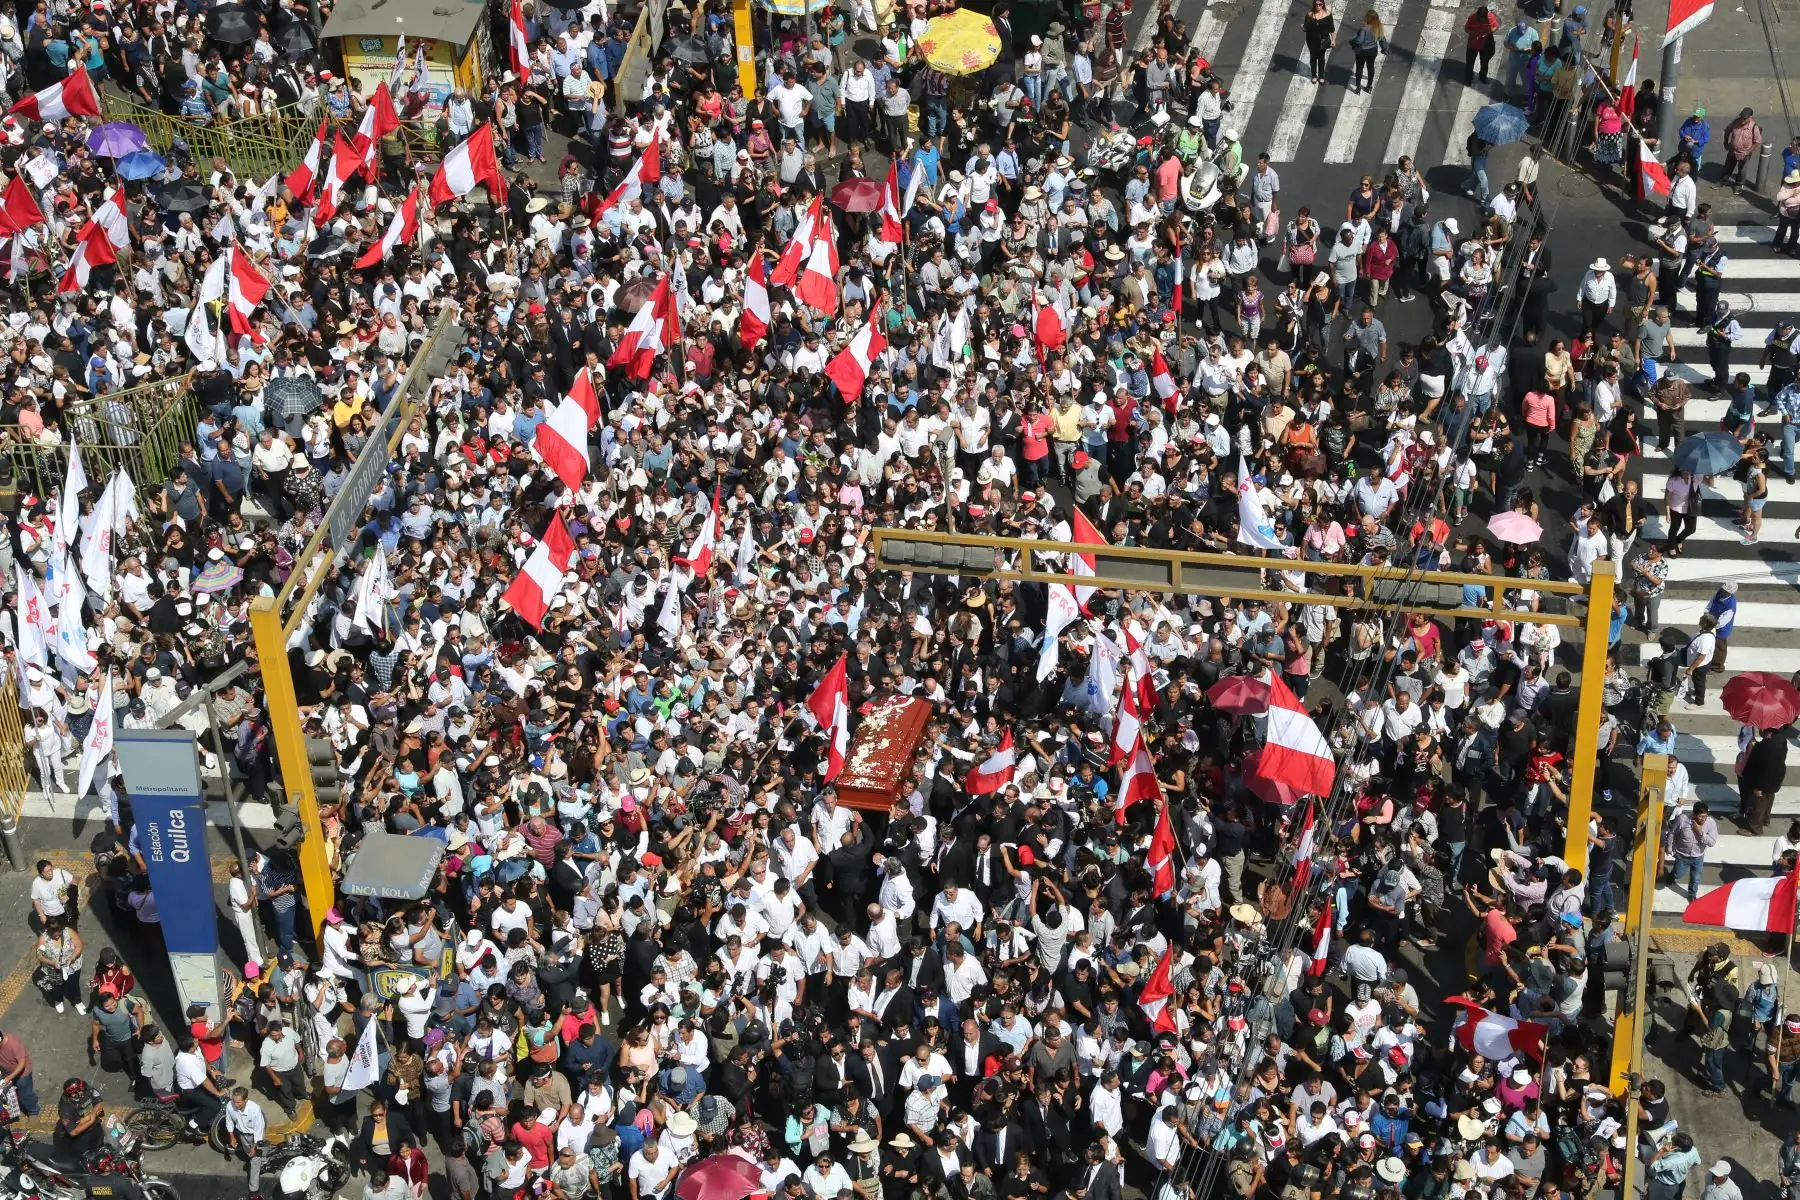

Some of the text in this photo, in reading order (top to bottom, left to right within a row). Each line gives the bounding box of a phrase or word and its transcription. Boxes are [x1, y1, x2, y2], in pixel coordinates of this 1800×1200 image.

[337, 443, 385, 537] JR. ZORRITOS
[136, 785, 188, 793] Metropolitano
[148, 822, 164, 862] Estación
[168, 809, 190, 863] Quilca
[351, 884, 411, 899] INCA KOLA
[419, 868, 432, 890] INCA
